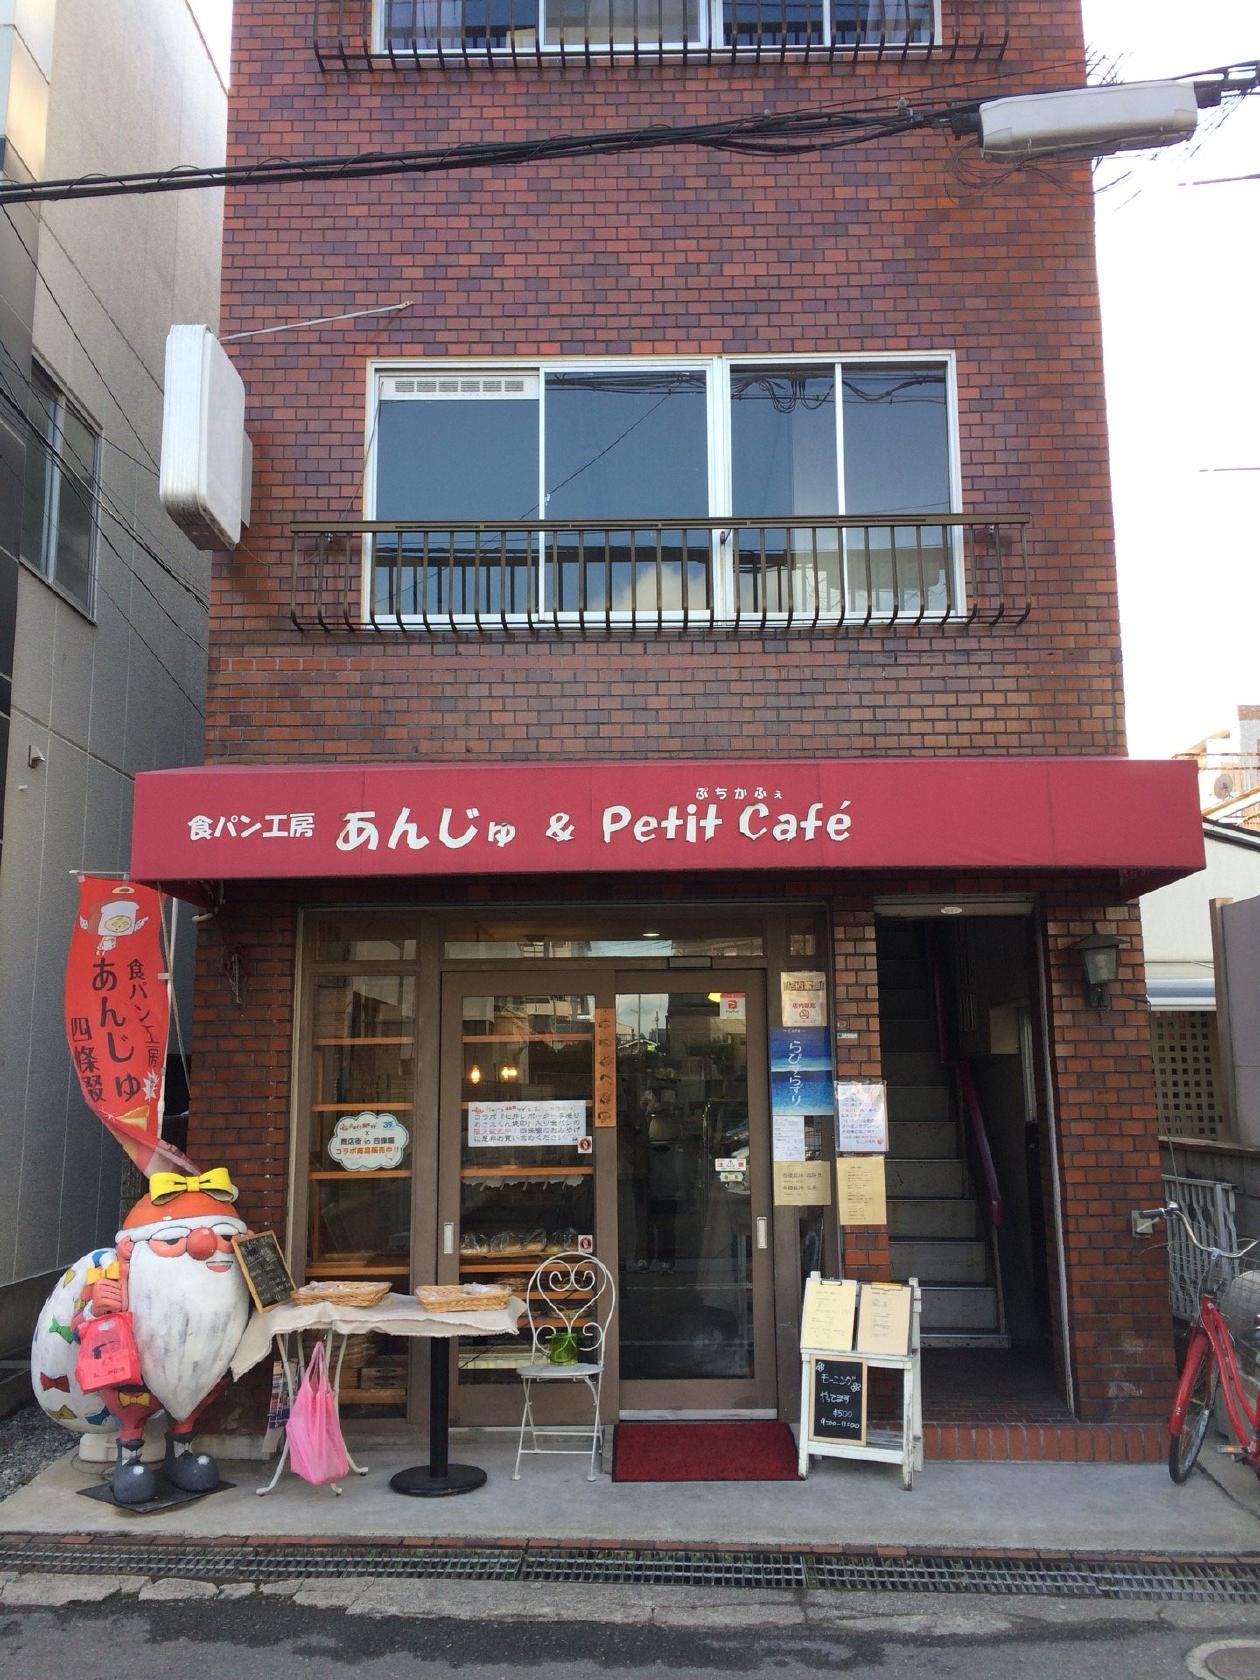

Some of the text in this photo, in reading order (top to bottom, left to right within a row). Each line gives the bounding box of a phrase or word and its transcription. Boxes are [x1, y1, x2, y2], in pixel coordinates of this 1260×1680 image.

[696, 787, 783, 800] ぷちかふぇ
[187, 800, 852, 851] 食パン工房 あんじゅ & Petit Café
[821, 1373, 856, 1385] モーニング
